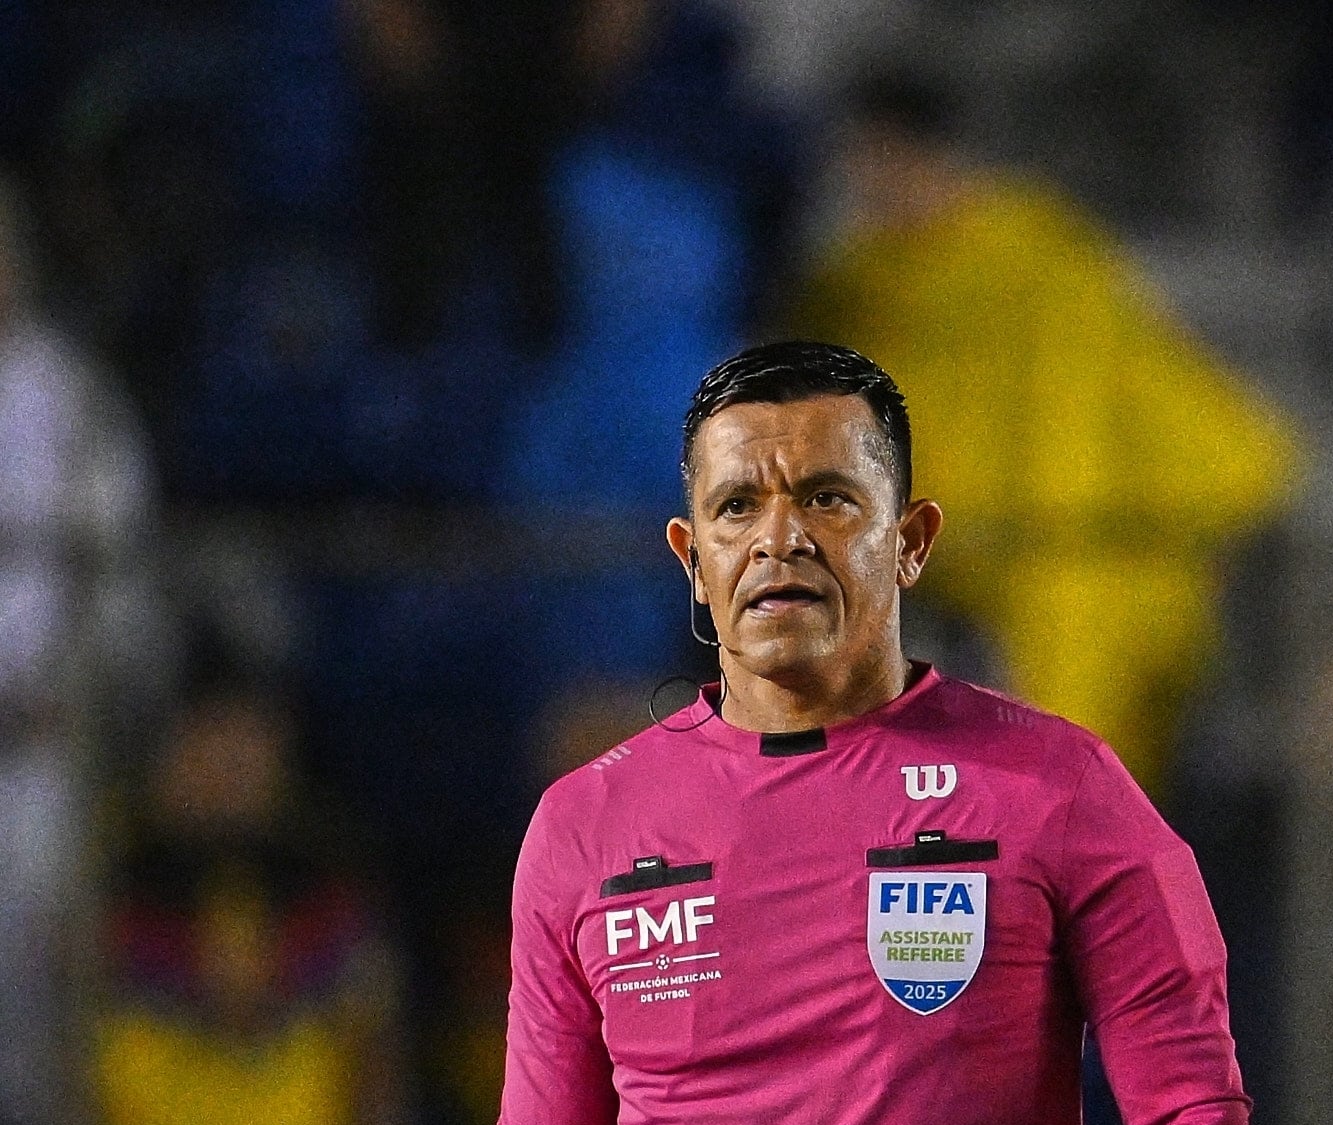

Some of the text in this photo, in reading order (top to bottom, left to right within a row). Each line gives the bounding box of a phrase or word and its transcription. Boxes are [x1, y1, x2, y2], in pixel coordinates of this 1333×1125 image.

[879, 881, 974, 915] FIFA
[605, 895, 715, 955] FMF
[879, 930, 974, 946] ASSISTANT
[886, 947, 966, 962] REFEREE
[610, 970, 722, 993] FEDERACIÓN MEXICANA
[640, 988, 691, 1003] DE FUTBOL
[903, 984, 947, 1000] 2025
